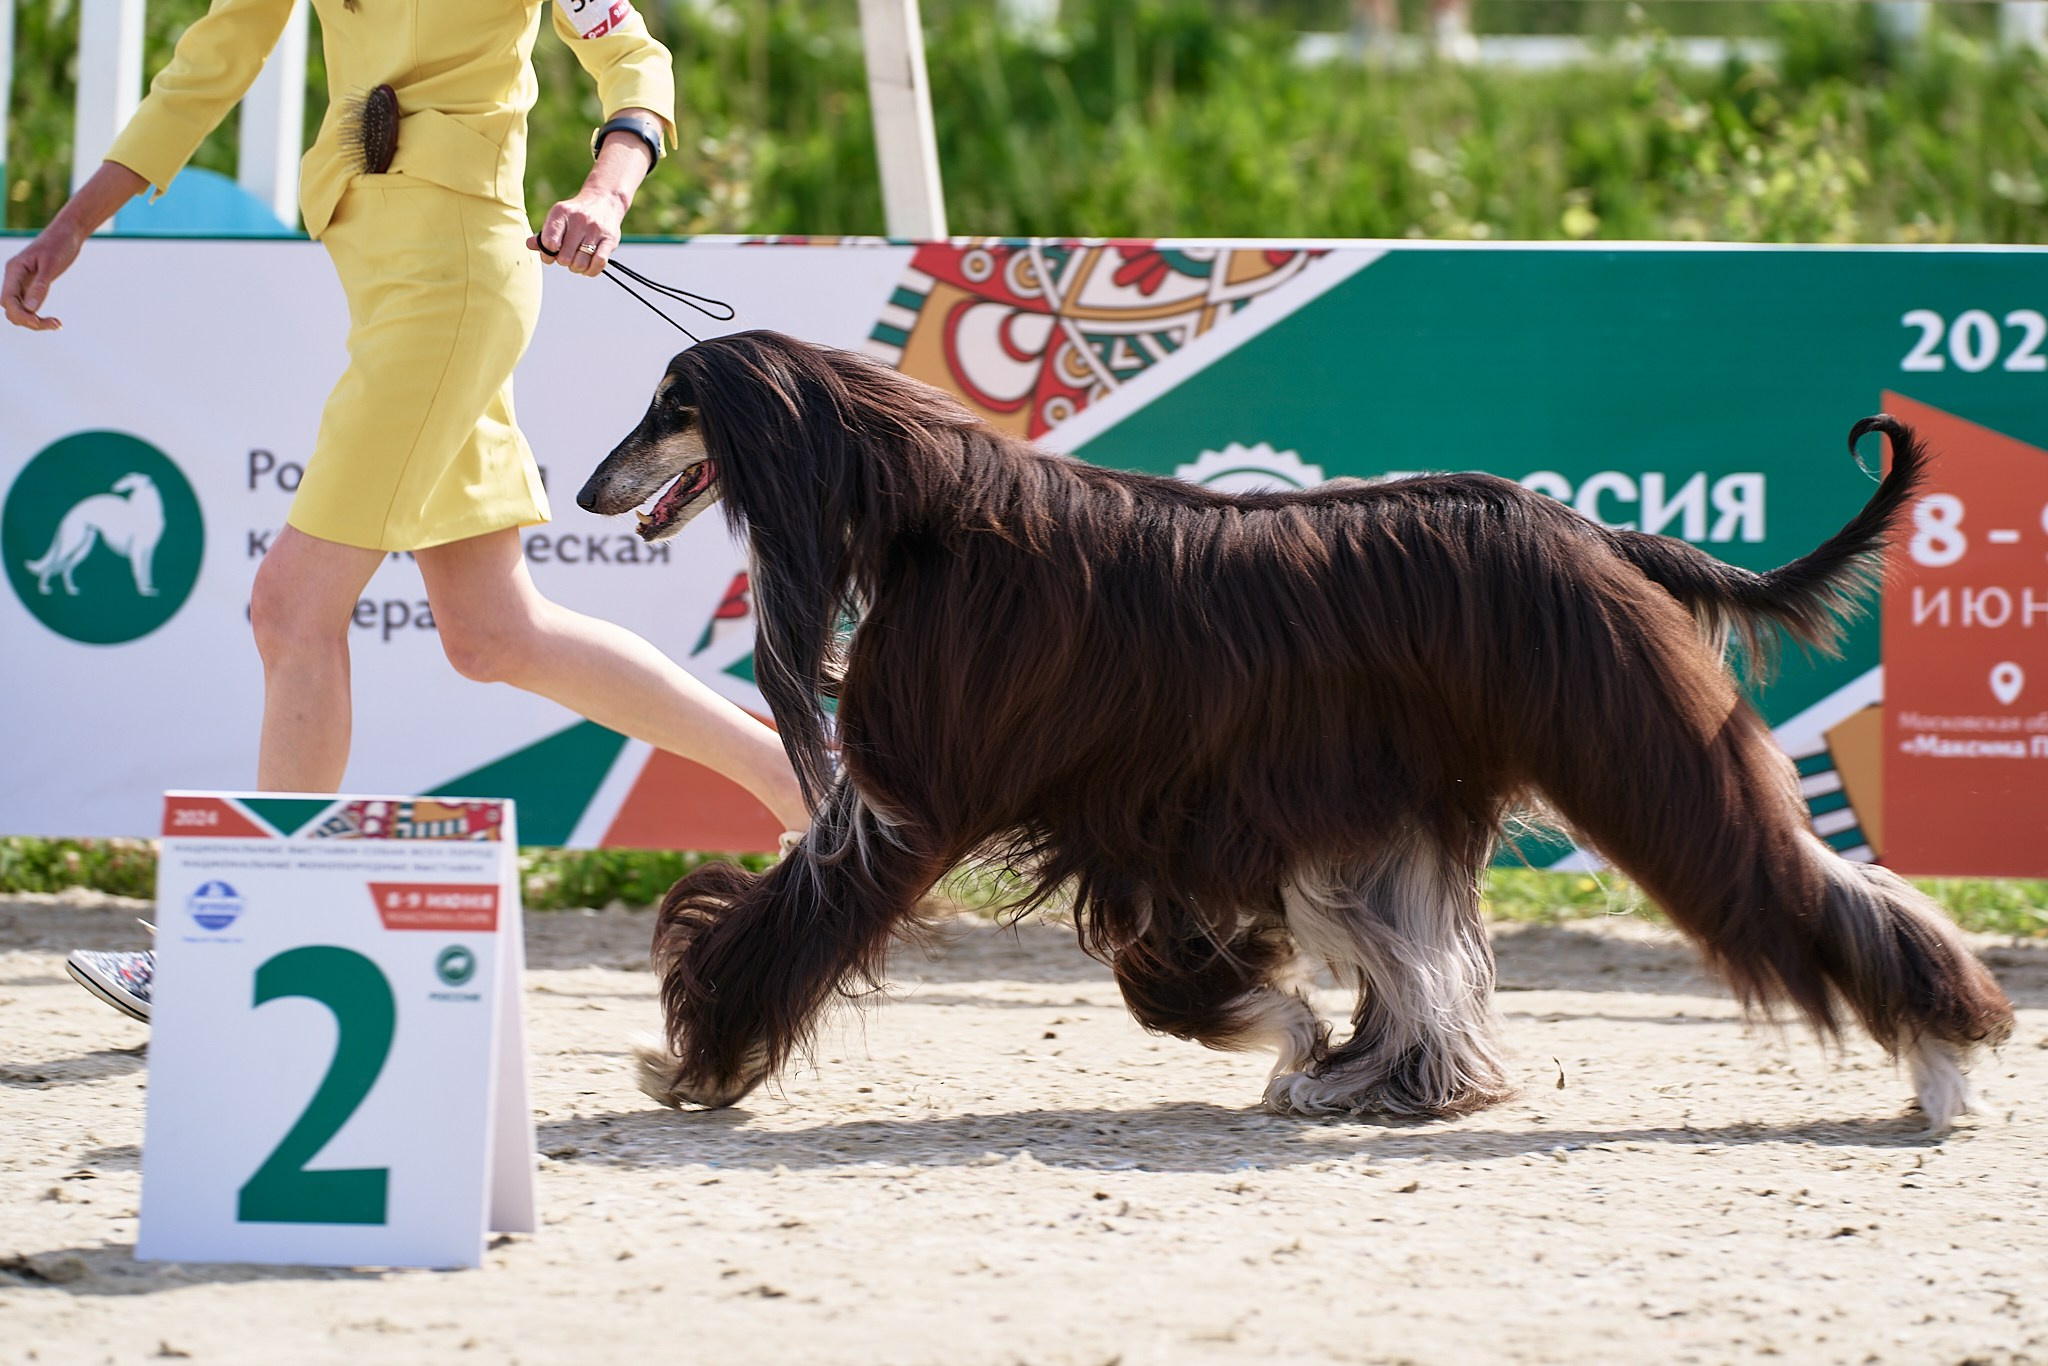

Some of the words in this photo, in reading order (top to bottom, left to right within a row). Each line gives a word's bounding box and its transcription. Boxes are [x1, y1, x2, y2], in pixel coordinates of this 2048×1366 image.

[1900, 309, 2048, 373] 202
[1909, 493, 1967, 567] 8
[173, 809, 219, 827] 2024
[236, 944, 397, 1226] 2
